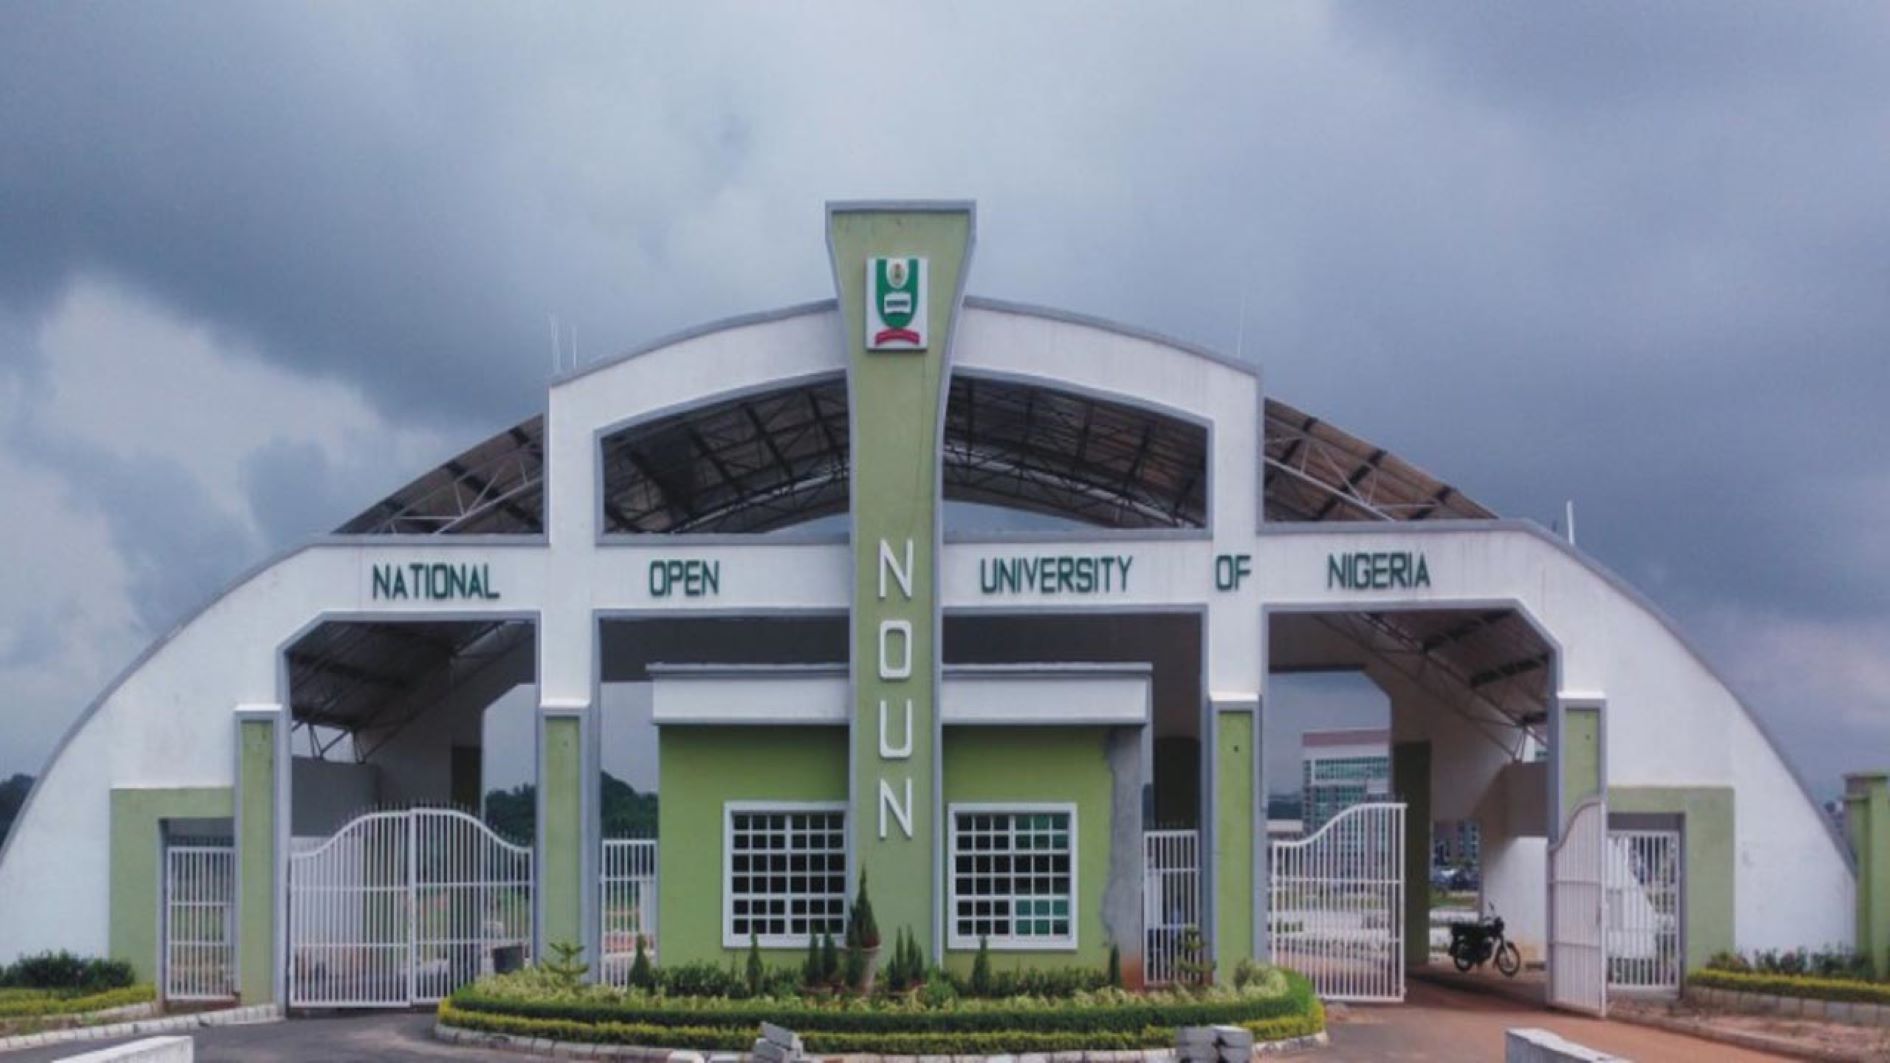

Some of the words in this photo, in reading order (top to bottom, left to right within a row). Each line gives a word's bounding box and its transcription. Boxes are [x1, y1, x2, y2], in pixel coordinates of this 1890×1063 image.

[372, 562, 499, 600] NATIONAL
[649, 559, 719, 597] OPEN
[980, 555, 1133, 595] UNIVERSITY
[1215, 554, 1252, 593] OF
[1327, 551, 1431, 590] NIGERIA
[879, 538, 913, 839] NOUN
